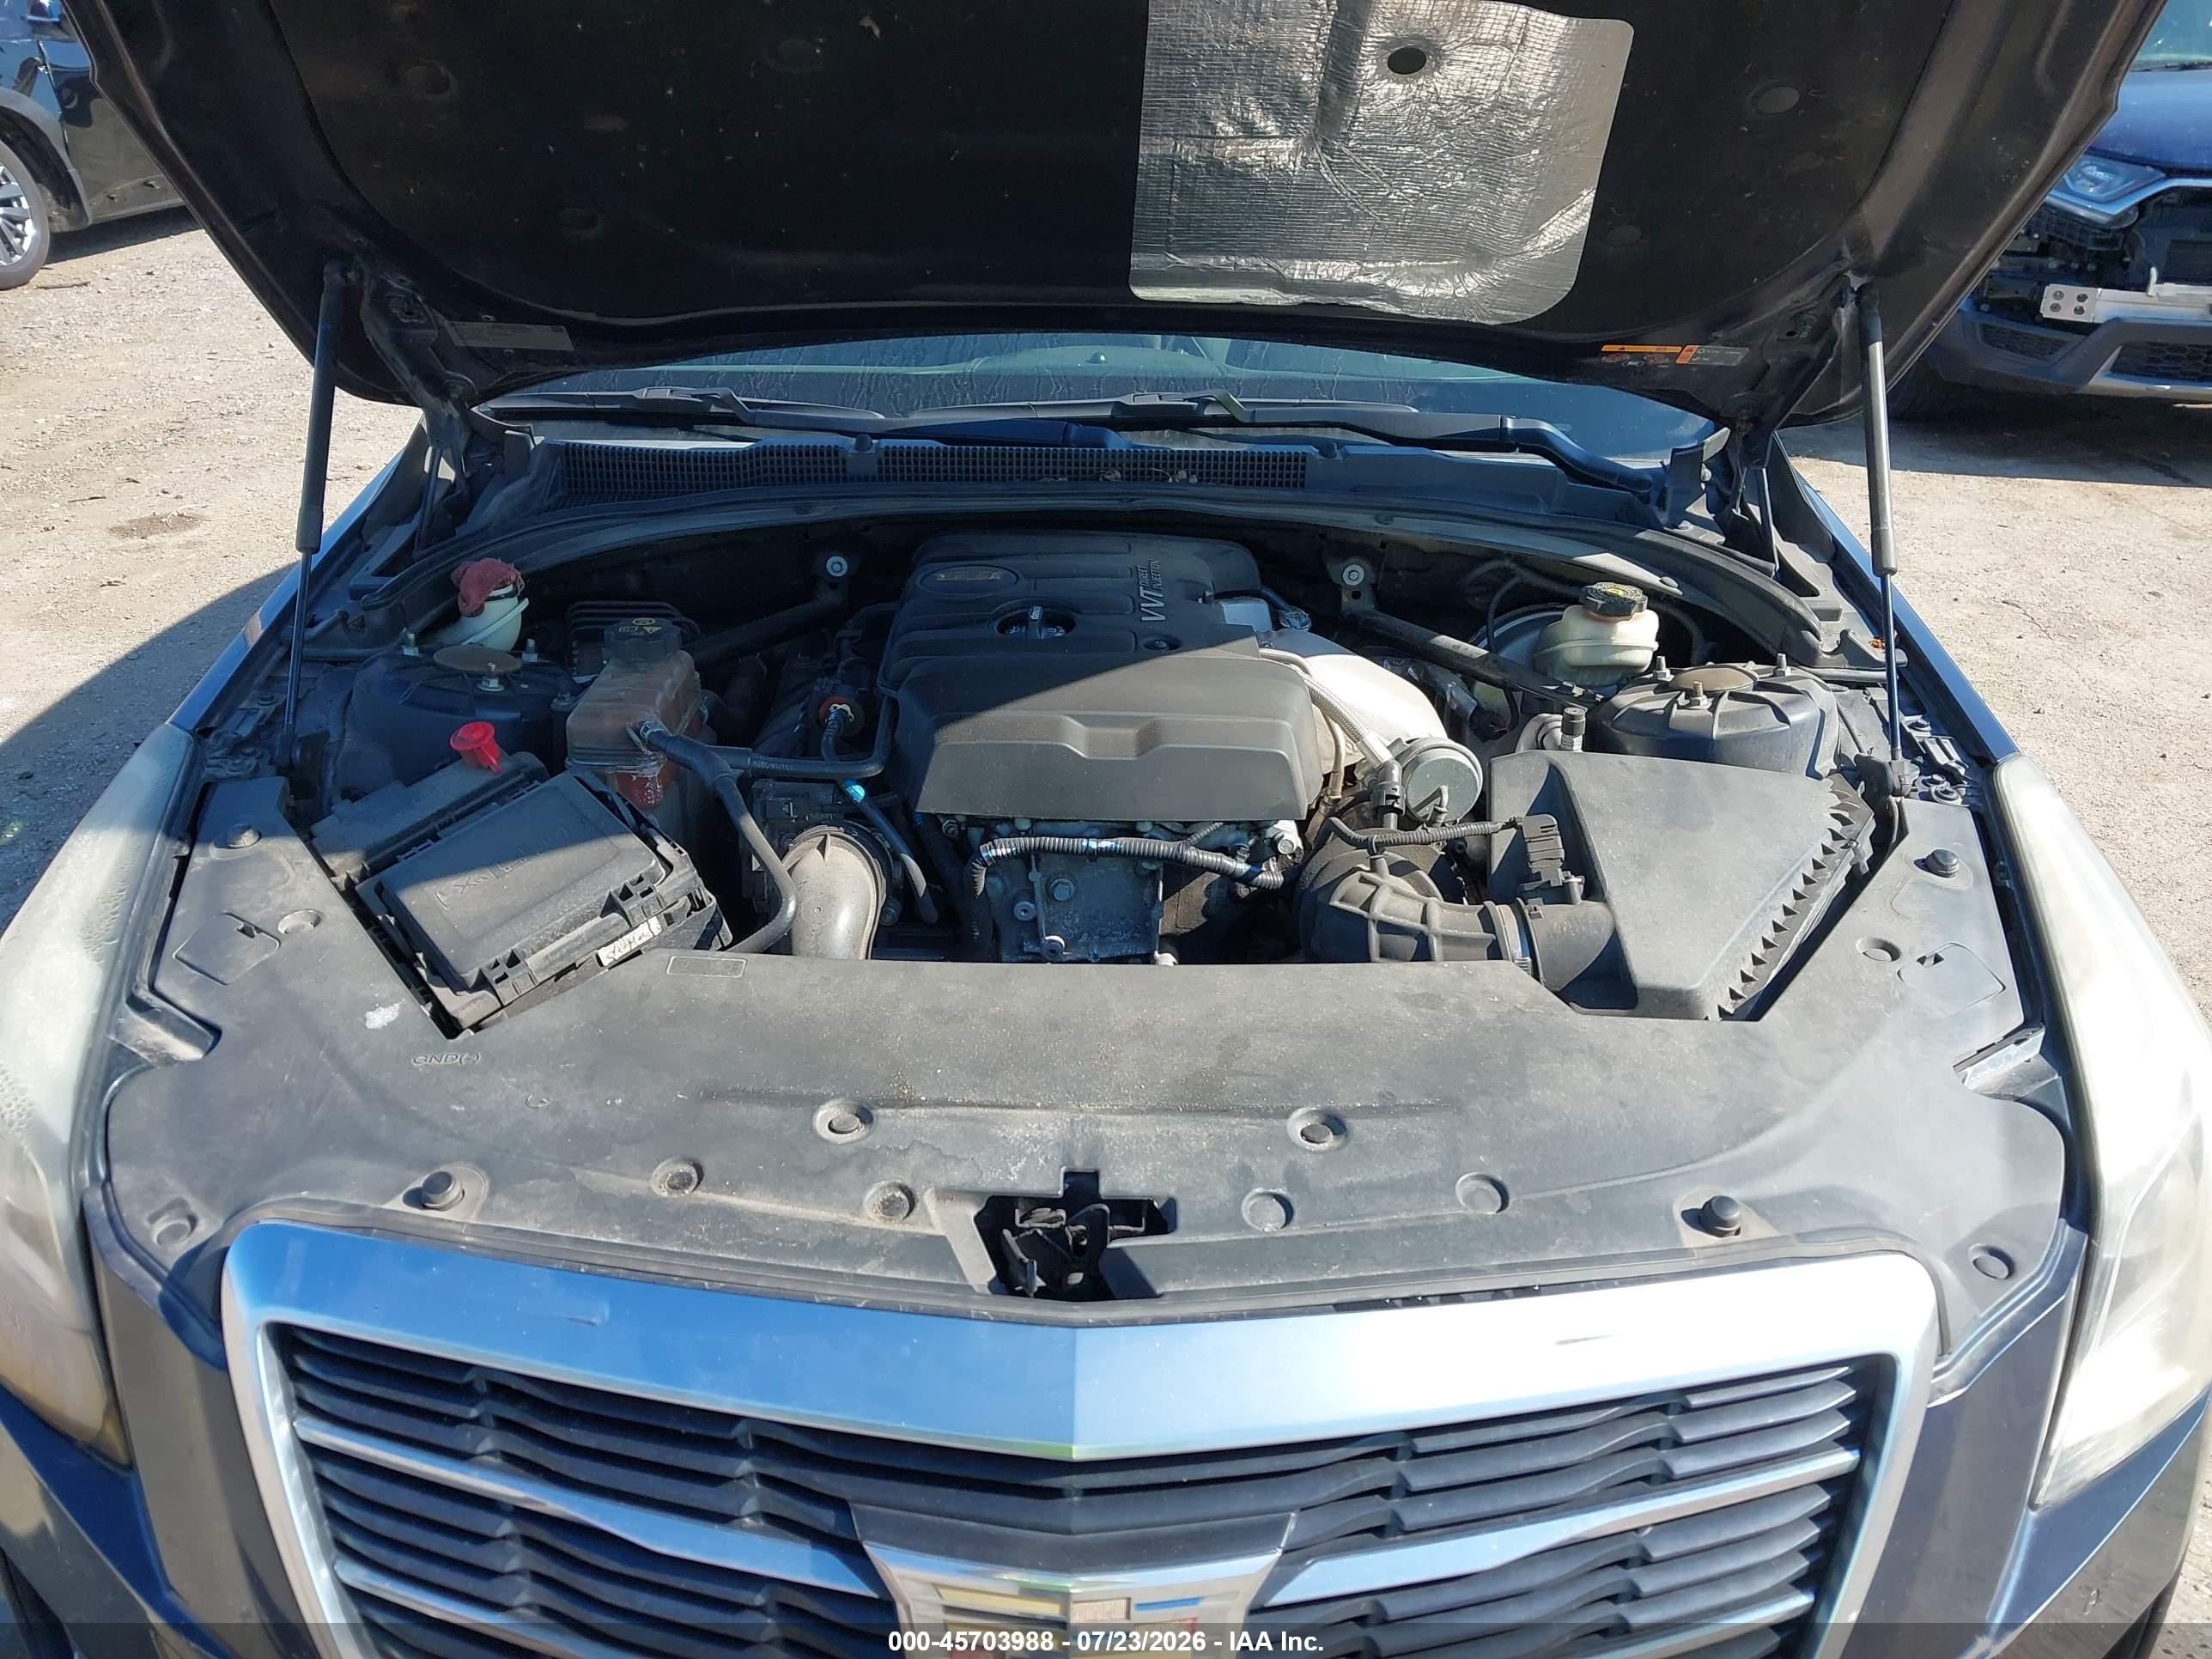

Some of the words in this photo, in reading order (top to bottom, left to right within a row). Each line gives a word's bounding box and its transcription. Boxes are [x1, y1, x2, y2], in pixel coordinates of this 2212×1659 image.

[1138, 564, 1149, 586] DIRECT
[1148, 559, 1163, 590] INJECTION
[1139, 586, 1166, 621] VVT
[412, 1053, 481, 1066] GND(-)
